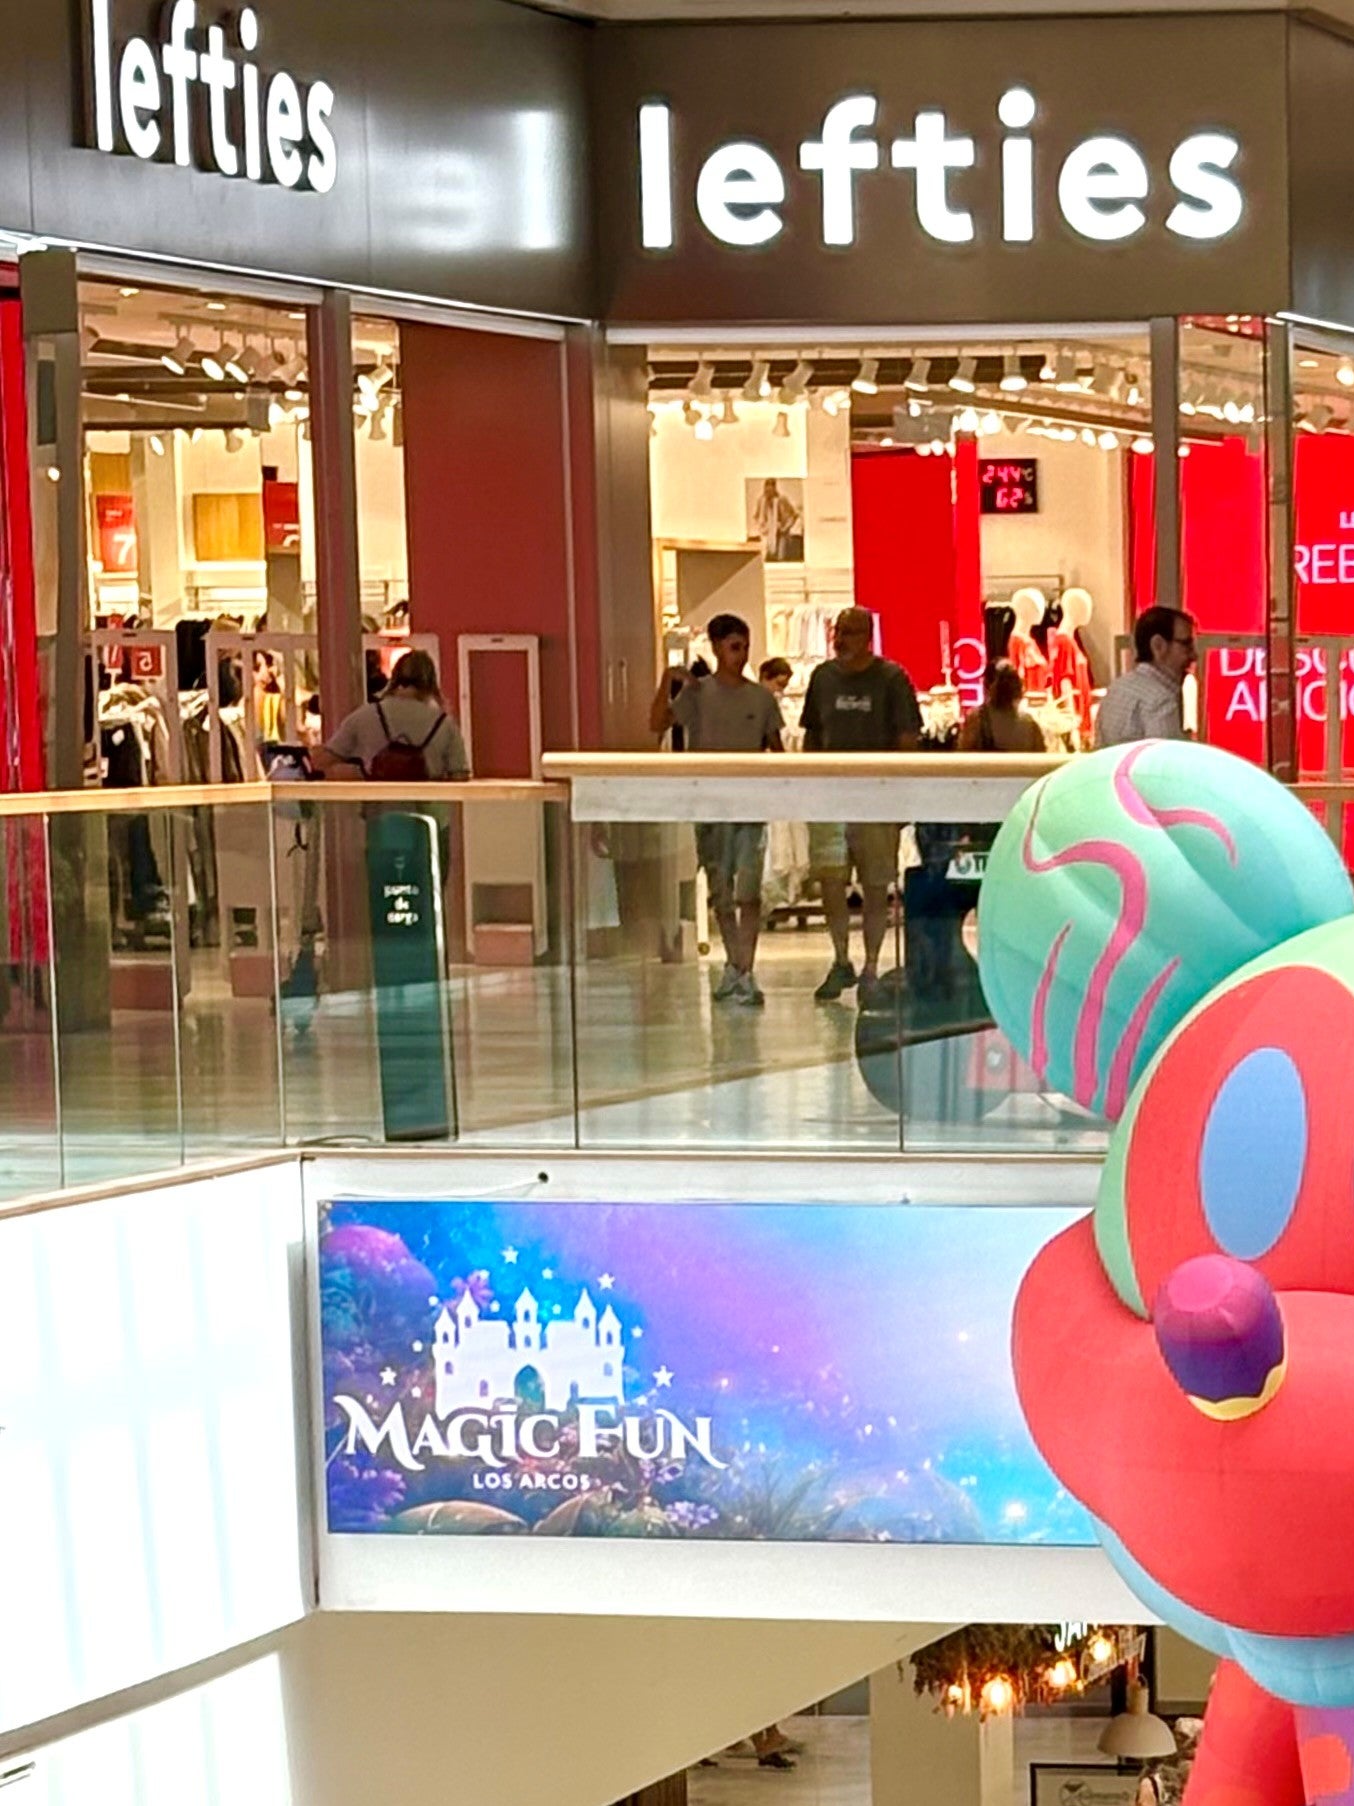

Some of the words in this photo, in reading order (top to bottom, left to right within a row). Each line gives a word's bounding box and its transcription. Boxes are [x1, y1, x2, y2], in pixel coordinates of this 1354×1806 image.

[92, 0, 337, 194] lefties
[638, 87, 1244, 248] lefties
[333, 1394, 560, 1471] MAGIC
[576, 1404, 730, 1470] FUN
[473, 1473, 512, 1490] LOS
[519, 1474, 591, 1491] ARCOS
